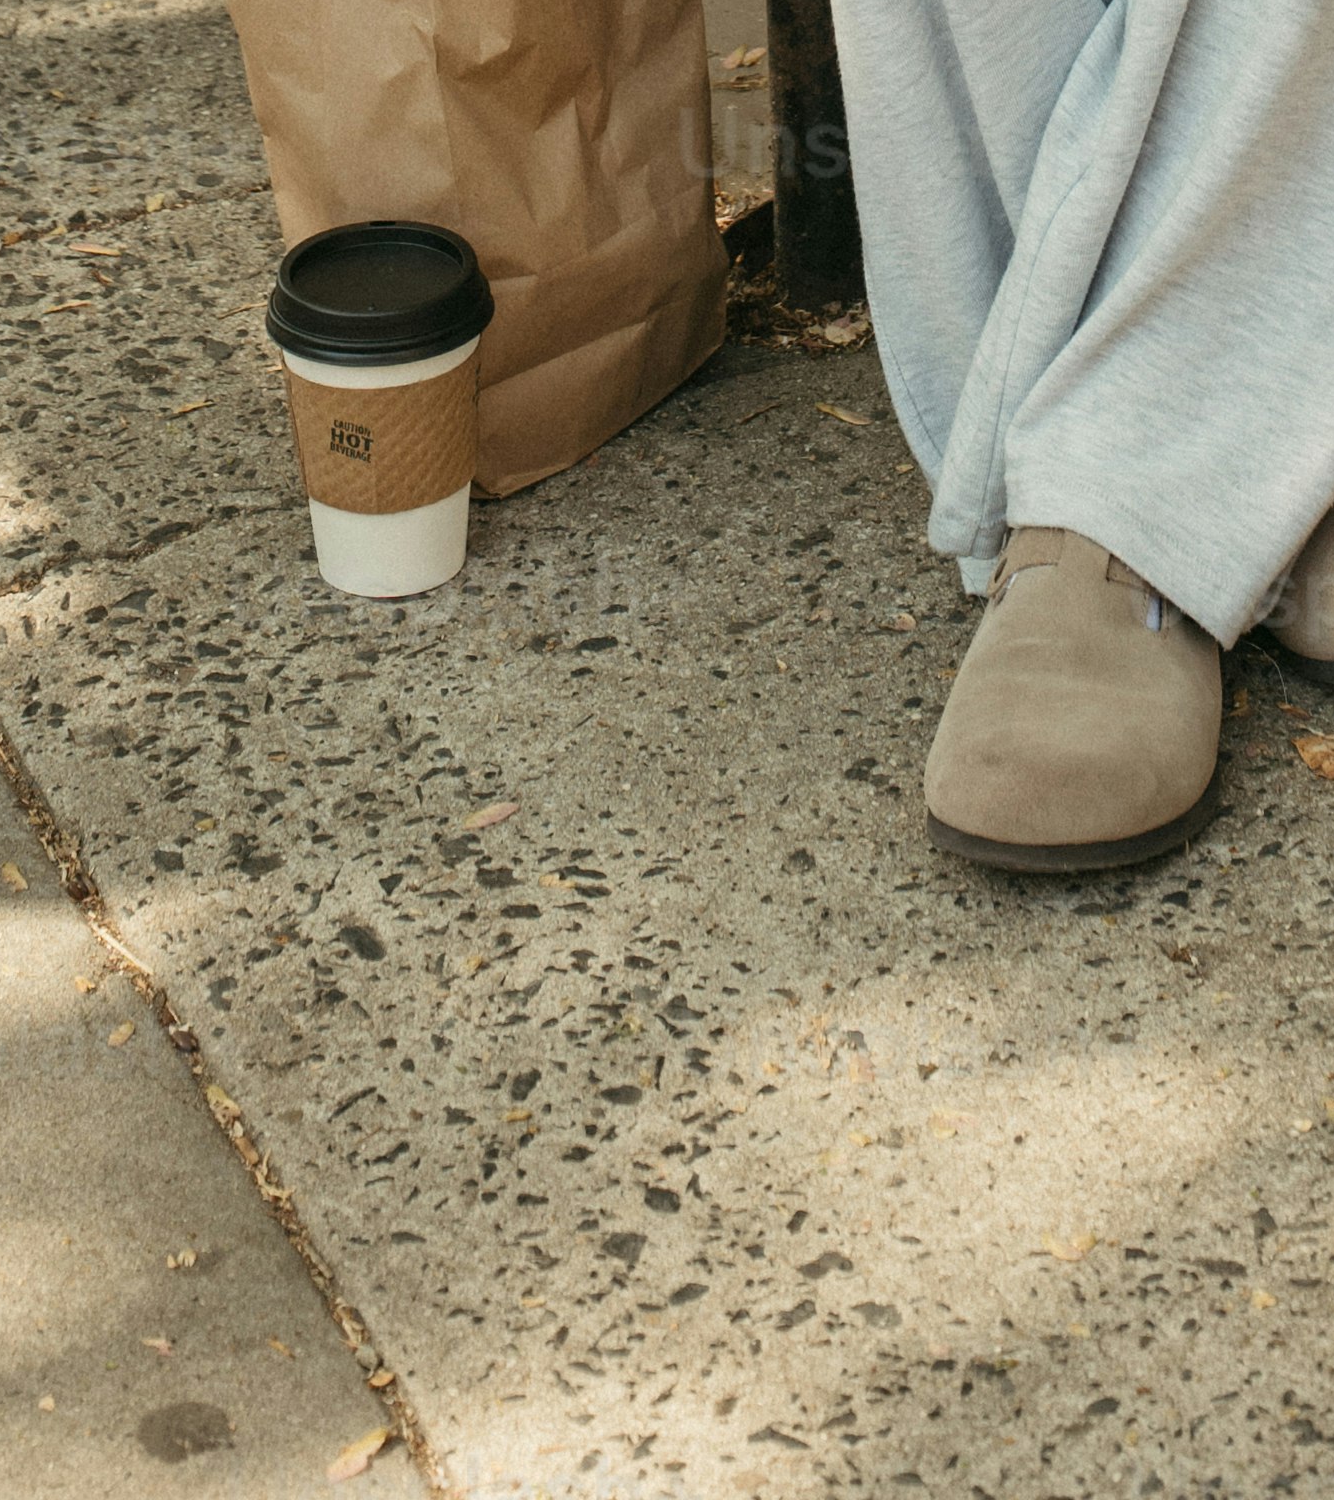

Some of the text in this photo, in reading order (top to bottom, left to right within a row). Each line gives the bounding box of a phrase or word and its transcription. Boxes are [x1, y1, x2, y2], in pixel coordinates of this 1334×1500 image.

[331, 427, 374, 452] HOT
[333, 419, 372, 437] CAUTION
[330, 441, 371, 464] BEVERAGE
